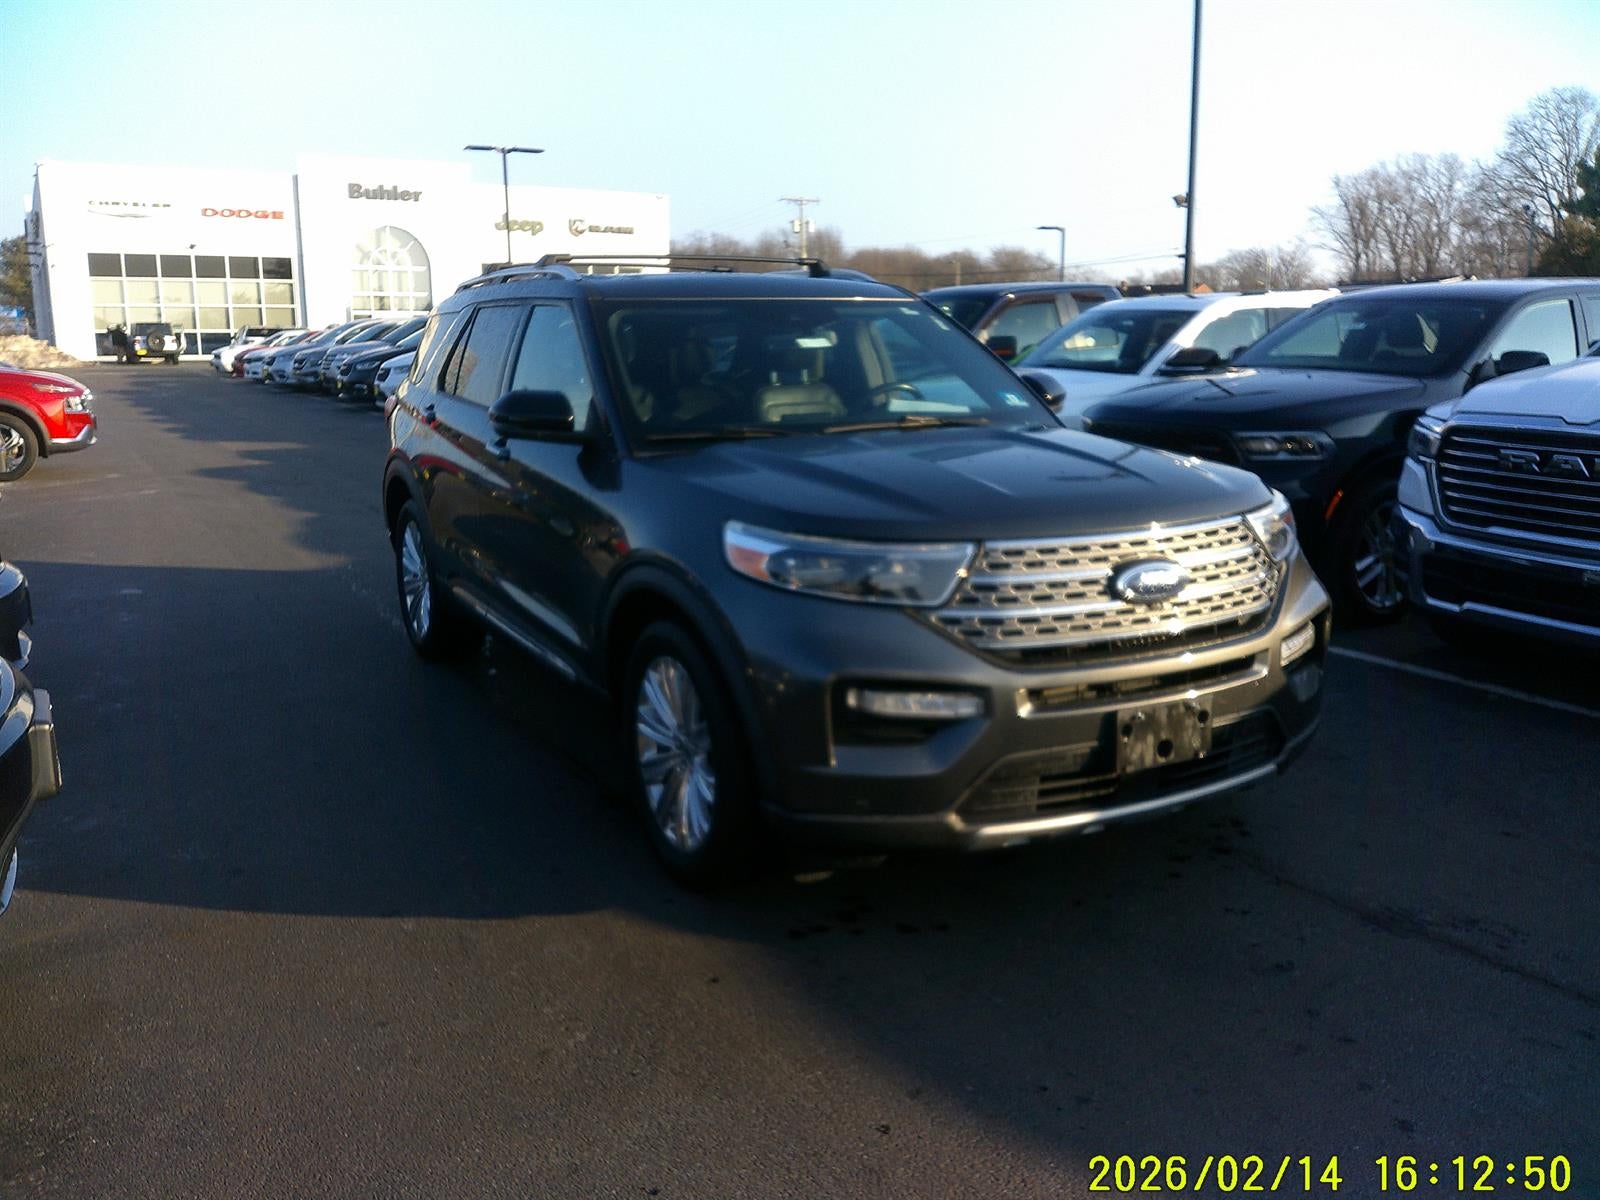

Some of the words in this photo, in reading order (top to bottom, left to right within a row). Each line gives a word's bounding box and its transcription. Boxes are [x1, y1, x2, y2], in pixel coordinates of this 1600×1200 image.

[347, 183, 423, 202] Buhler
[201, 207, 284, 220] DODGE
[495, 212, 544, 236] Jeep
[1499, 450, 1600, 478] RA
